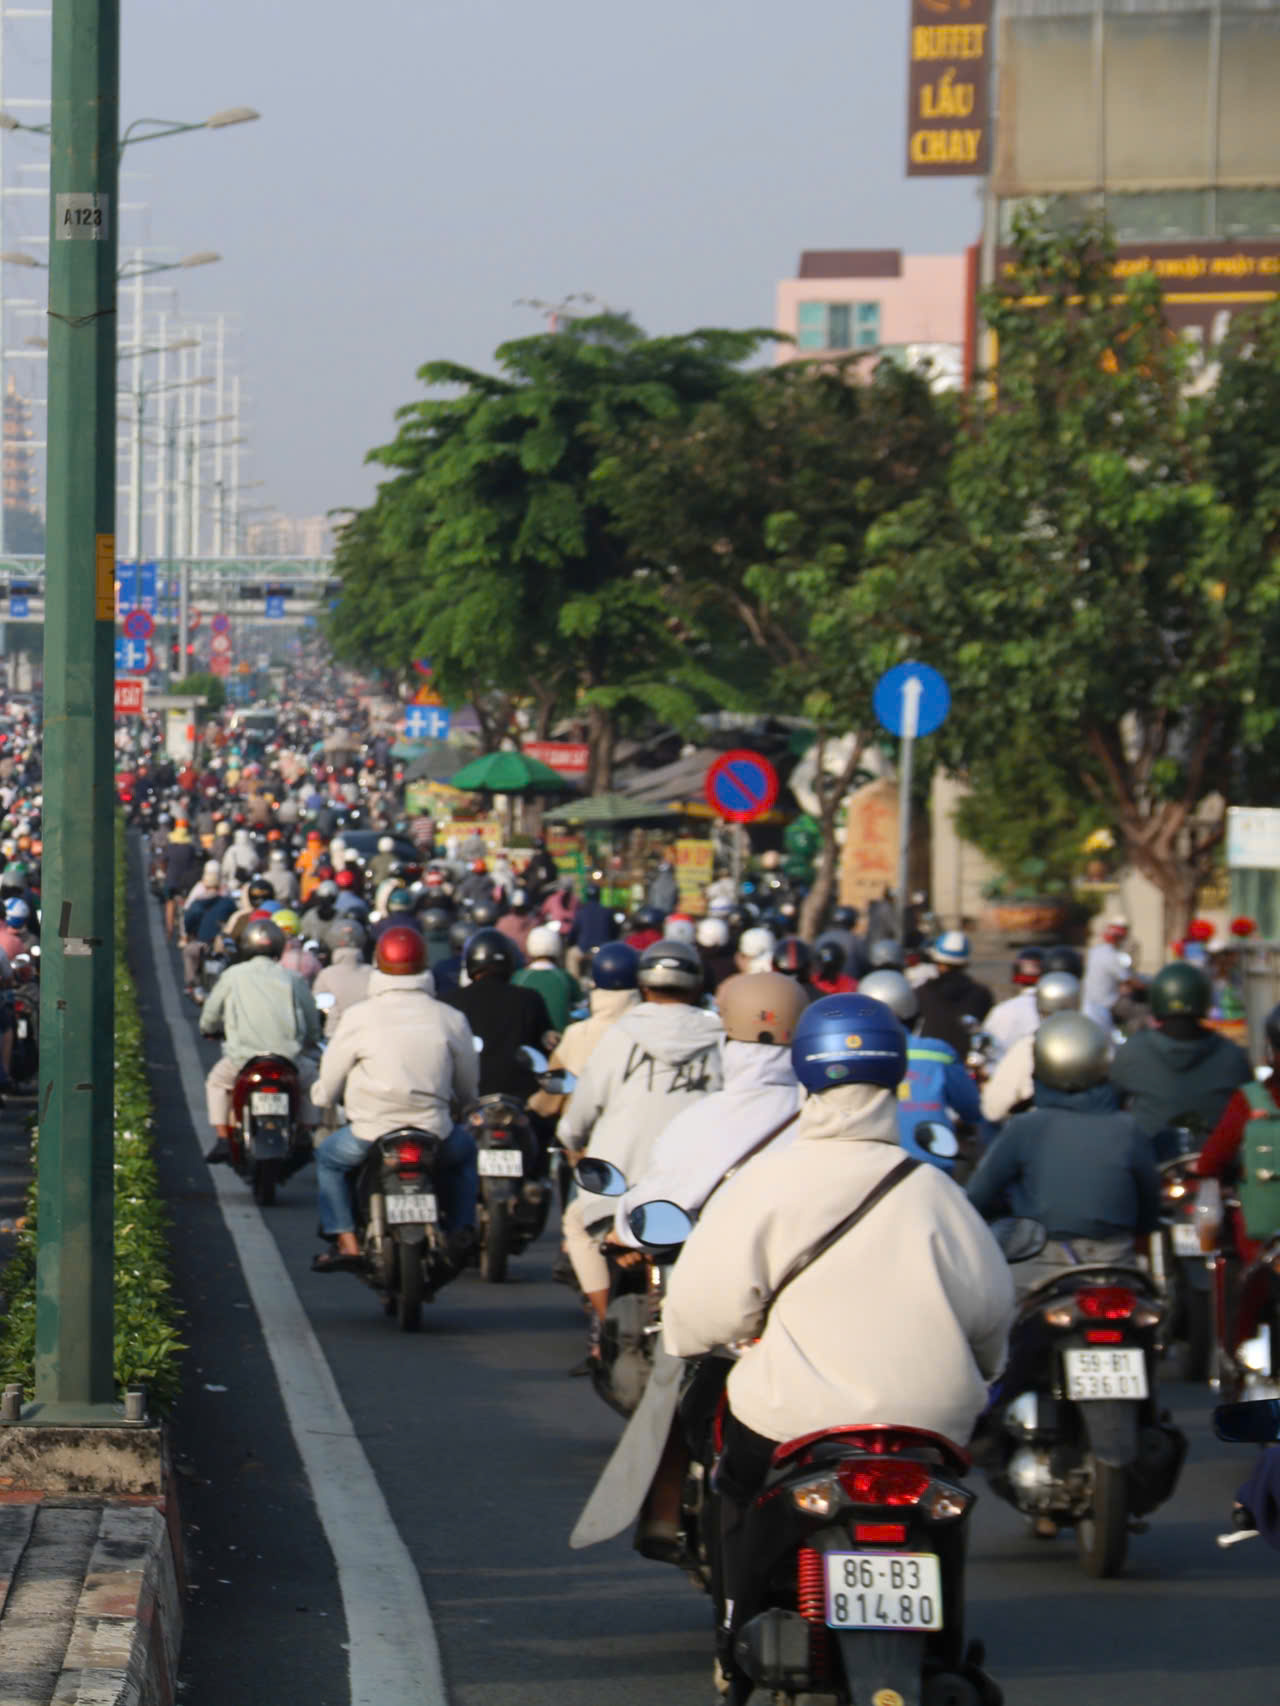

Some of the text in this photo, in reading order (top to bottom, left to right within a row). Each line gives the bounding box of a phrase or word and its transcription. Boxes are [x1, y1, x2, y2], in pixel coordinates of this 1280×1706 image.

[914, 24, 987, 60] BUFFET
[911, 129, 981, 164] CHAY
[64, 208, 102, 226] A123
[843, 1559, 921, 1589] 86-B3
[834, 1593, 934, 1625] 814.80
